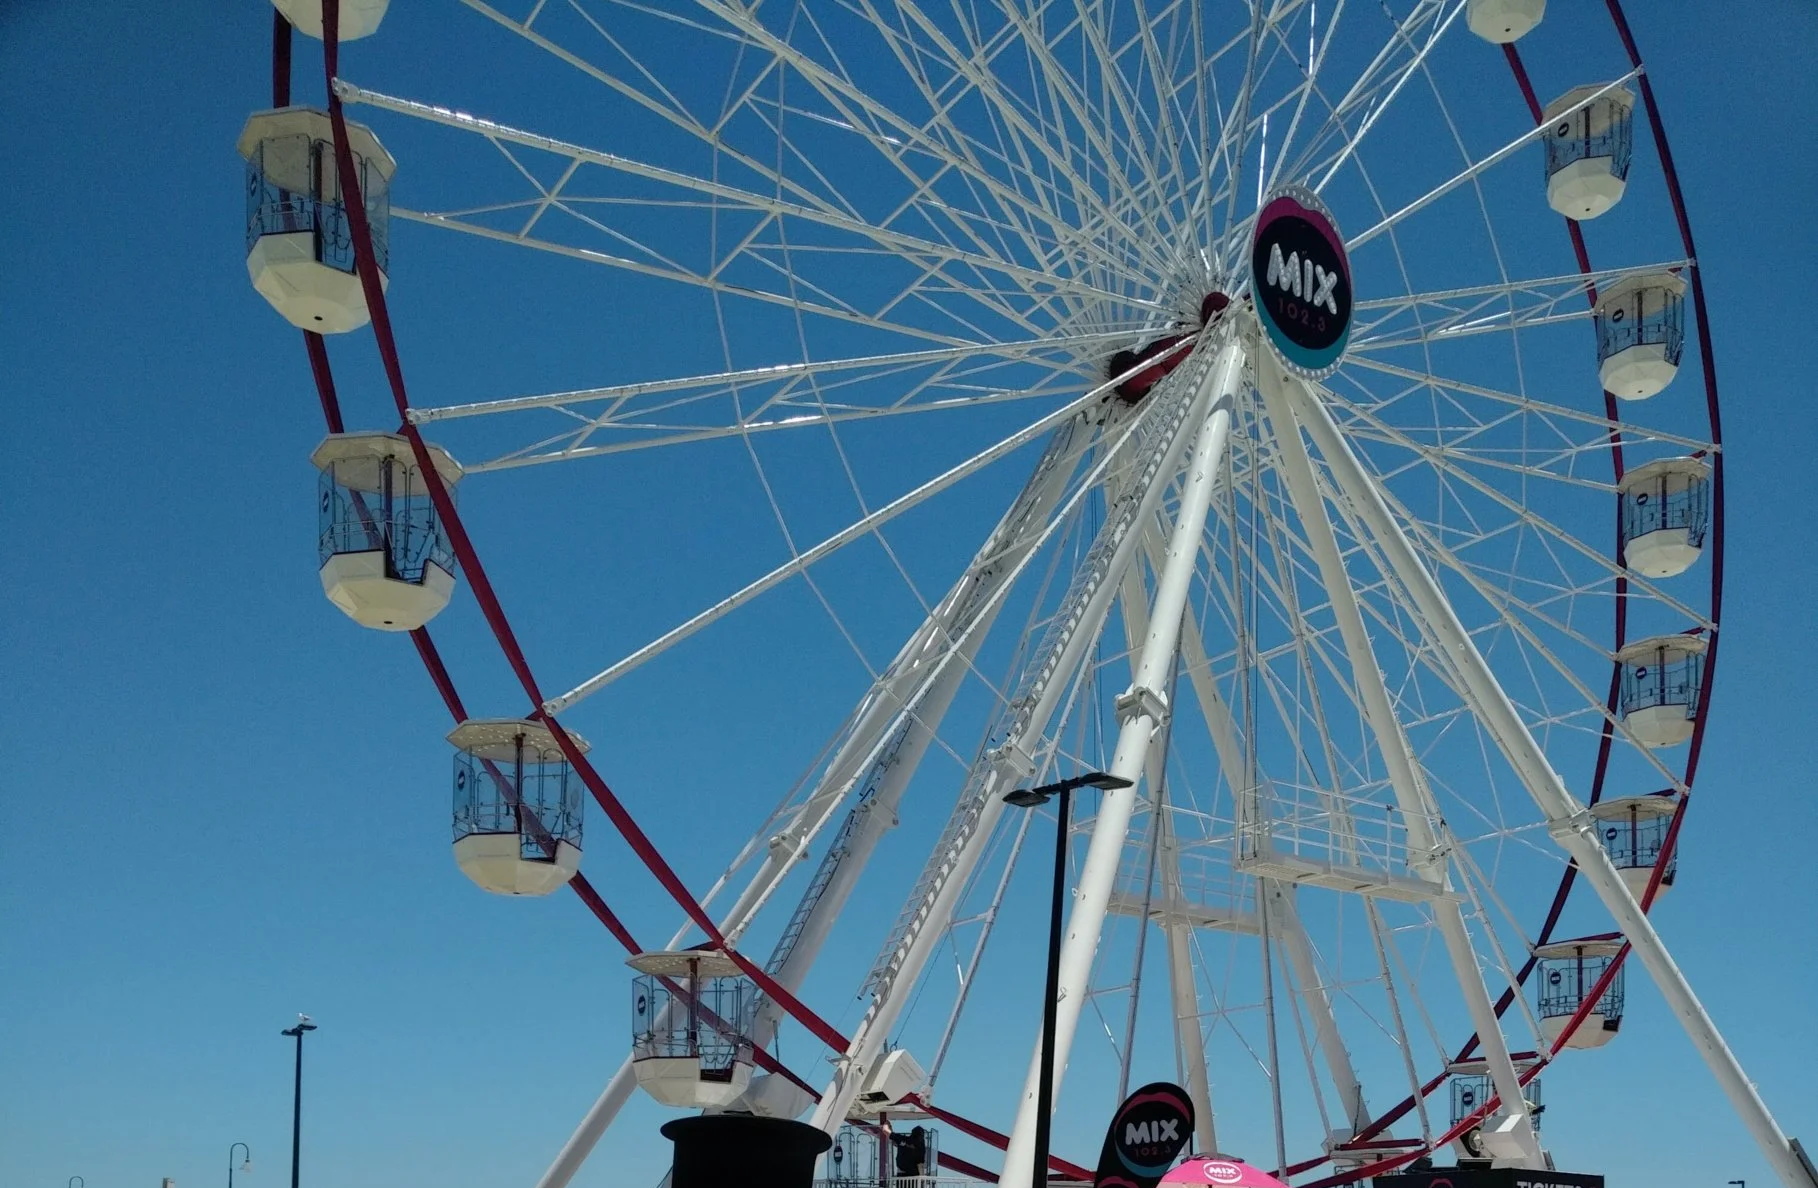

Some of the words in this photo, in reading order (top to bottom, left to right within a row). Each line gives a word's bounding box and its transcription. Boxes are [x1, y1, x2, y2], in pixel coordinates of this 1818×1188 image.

[1266, 242, 1338, 315] MIX
[1277, 297, 1326, 332] 102.3
[1125, 1118, 1180, 1146] MIX
[1209, 1166, 1236, 1175] MIX
